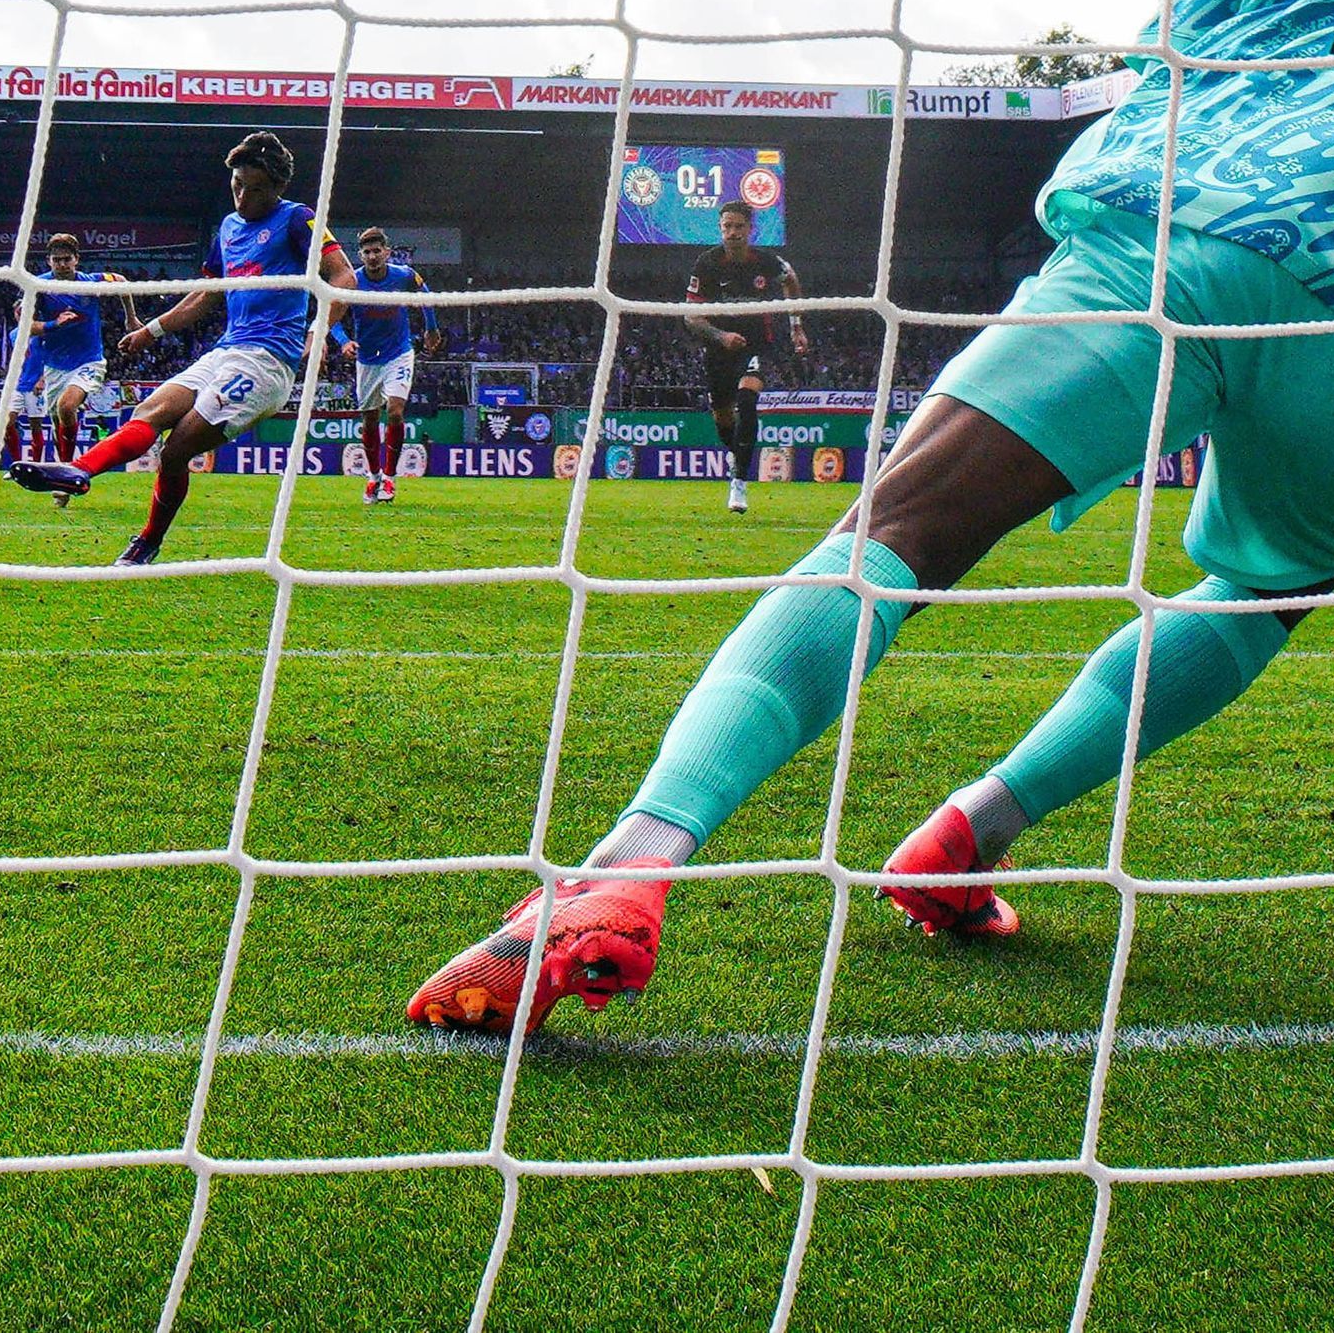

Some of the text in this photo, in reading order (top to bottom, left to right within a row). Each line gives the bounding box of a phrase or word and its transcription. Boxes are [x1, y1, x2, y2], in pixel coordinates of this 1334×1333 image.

[92, 68, 174, 100] famila
[517, 85, 838, 109] MARKANT MARKANT MARKANT
[904, 90, 991, 116] Rumpf
[677, 165, 723, 195] 0:1
[684, 196, 719, 209] 29:57
[84, 229, 136, 247] Vogel
[748, 356, 759, 370] 4
[221, 373, 254, 403] 18
[574, 418, 679, 446] Cllagon
[757, 419, 824, 447] lagon
[449, 448, 534, 477] FLENS
